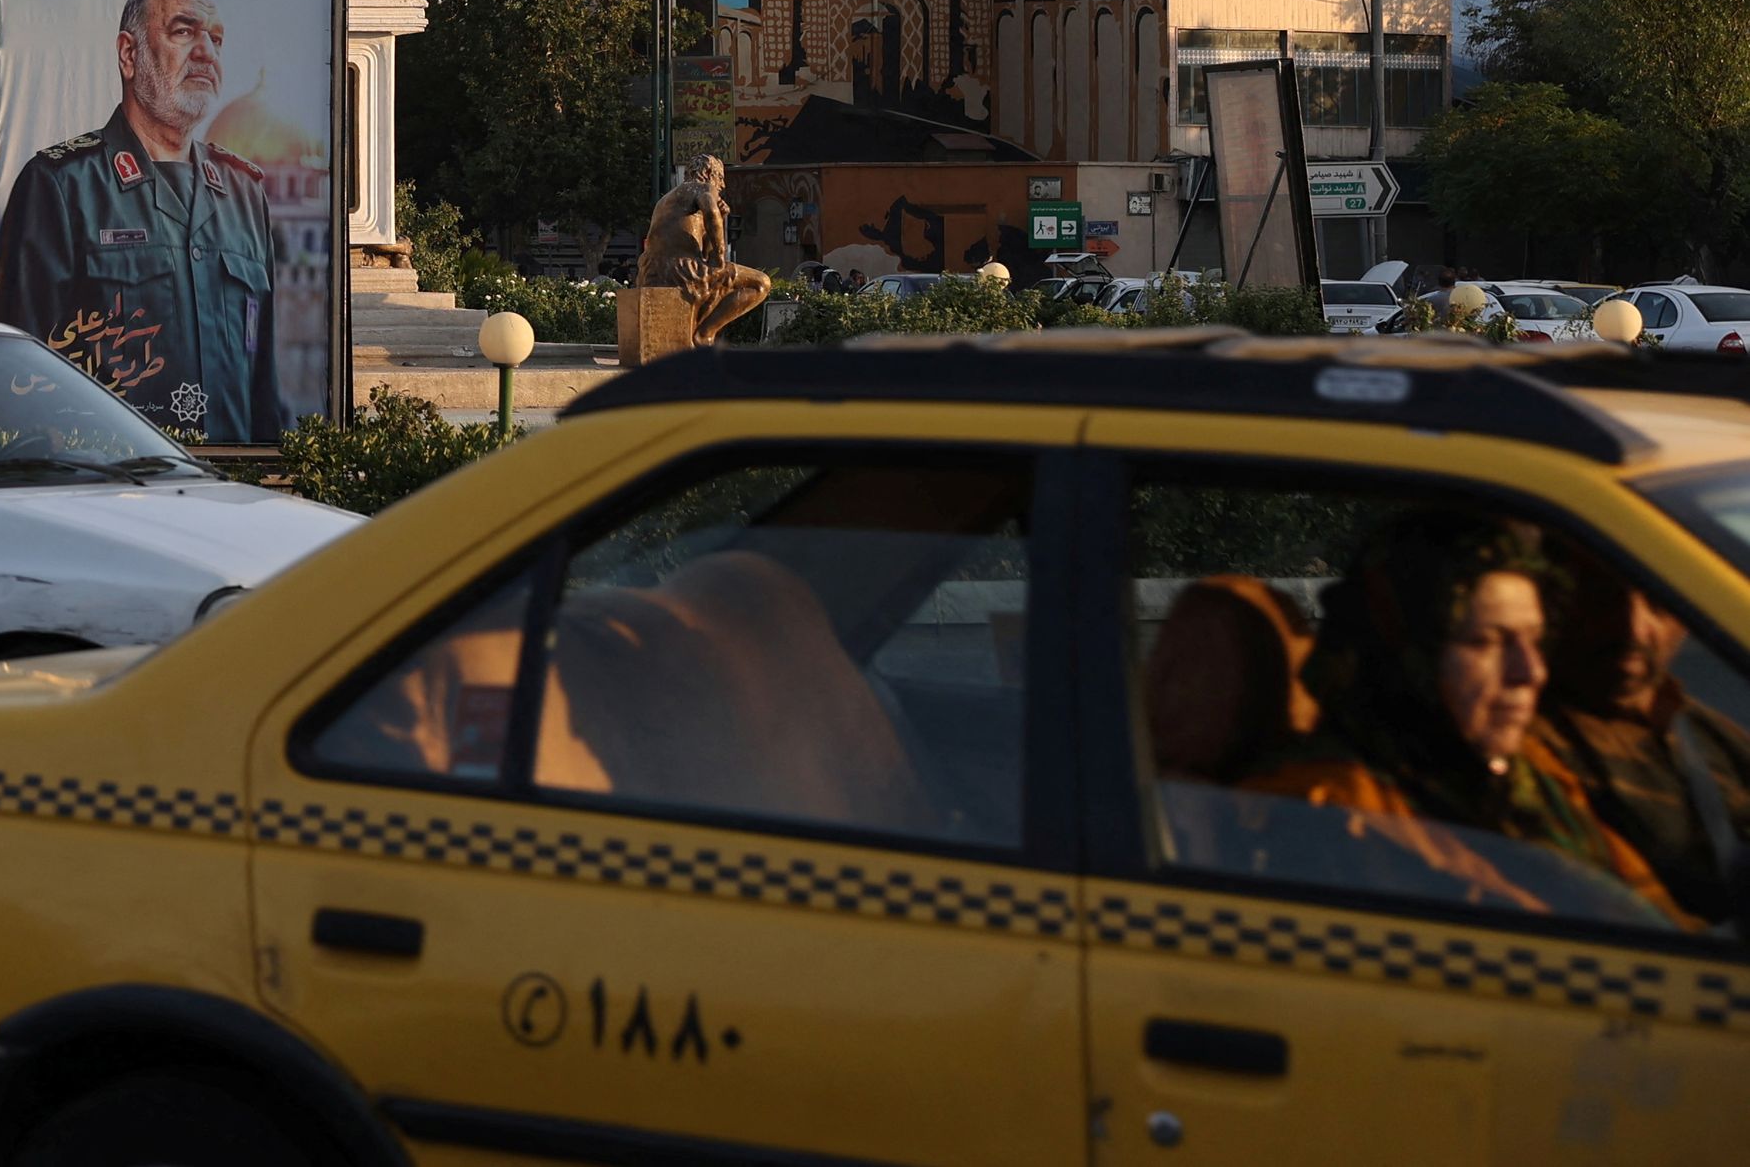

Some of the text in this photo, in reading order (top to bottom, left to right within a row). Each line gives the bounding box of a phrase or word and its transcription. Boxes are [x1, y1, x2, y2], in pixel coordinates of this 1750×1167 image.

[1333, 170, 1354, 180] شهید
[1311, 183, 1354, 195] شهید نواب
[1349, 198, 1363, 209] 27
[48, 308, 105, 350] علی
[103, 338, 166, 398] طریق
[143, 401, 165, 413] سردار
[589, 976, 742, 1064] ۱۸۸۰
